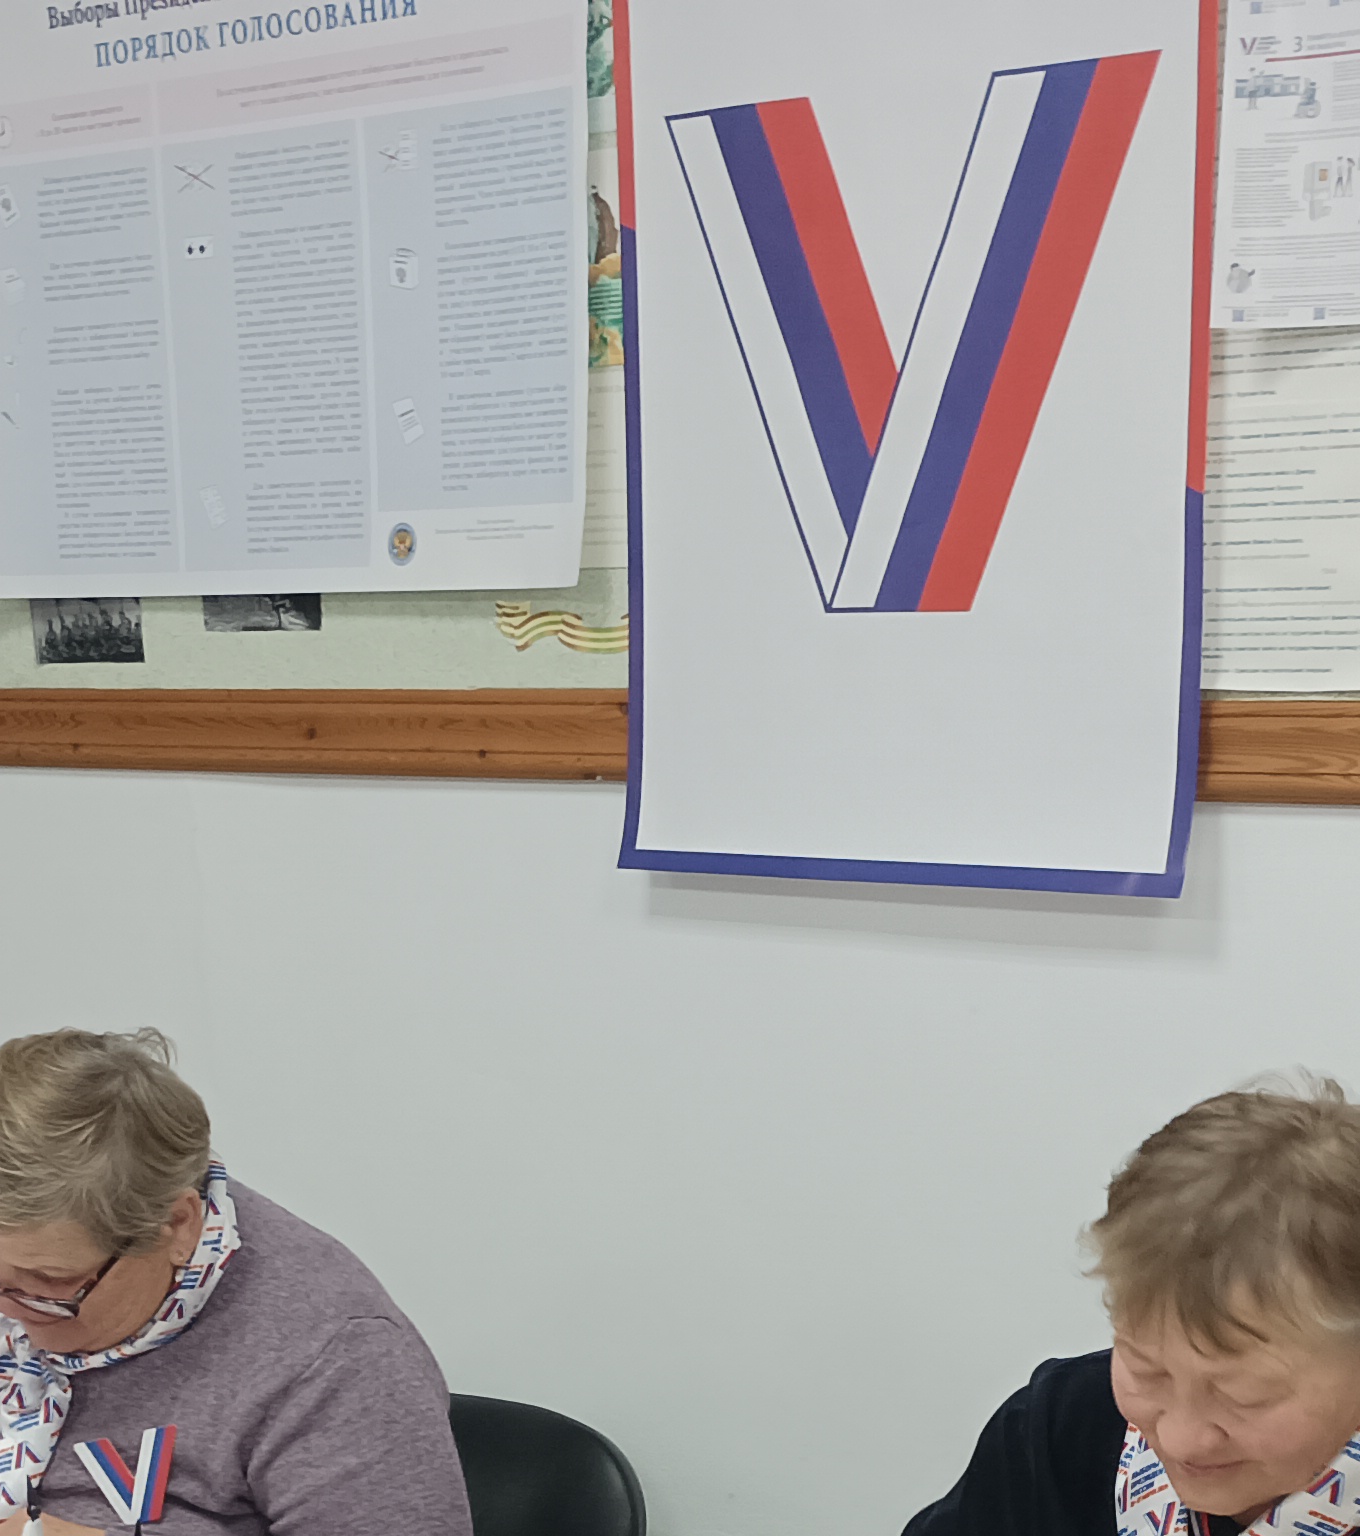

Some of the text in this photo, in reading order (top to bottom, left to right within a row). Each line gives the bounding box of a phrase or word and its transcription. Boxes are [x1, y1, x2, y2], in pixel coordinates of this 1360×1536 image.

[46, 1, 119, 29] Выборы
[94, 0, 417, 67] ПОРЯДОК ГОЛОСОВАНИЯ
